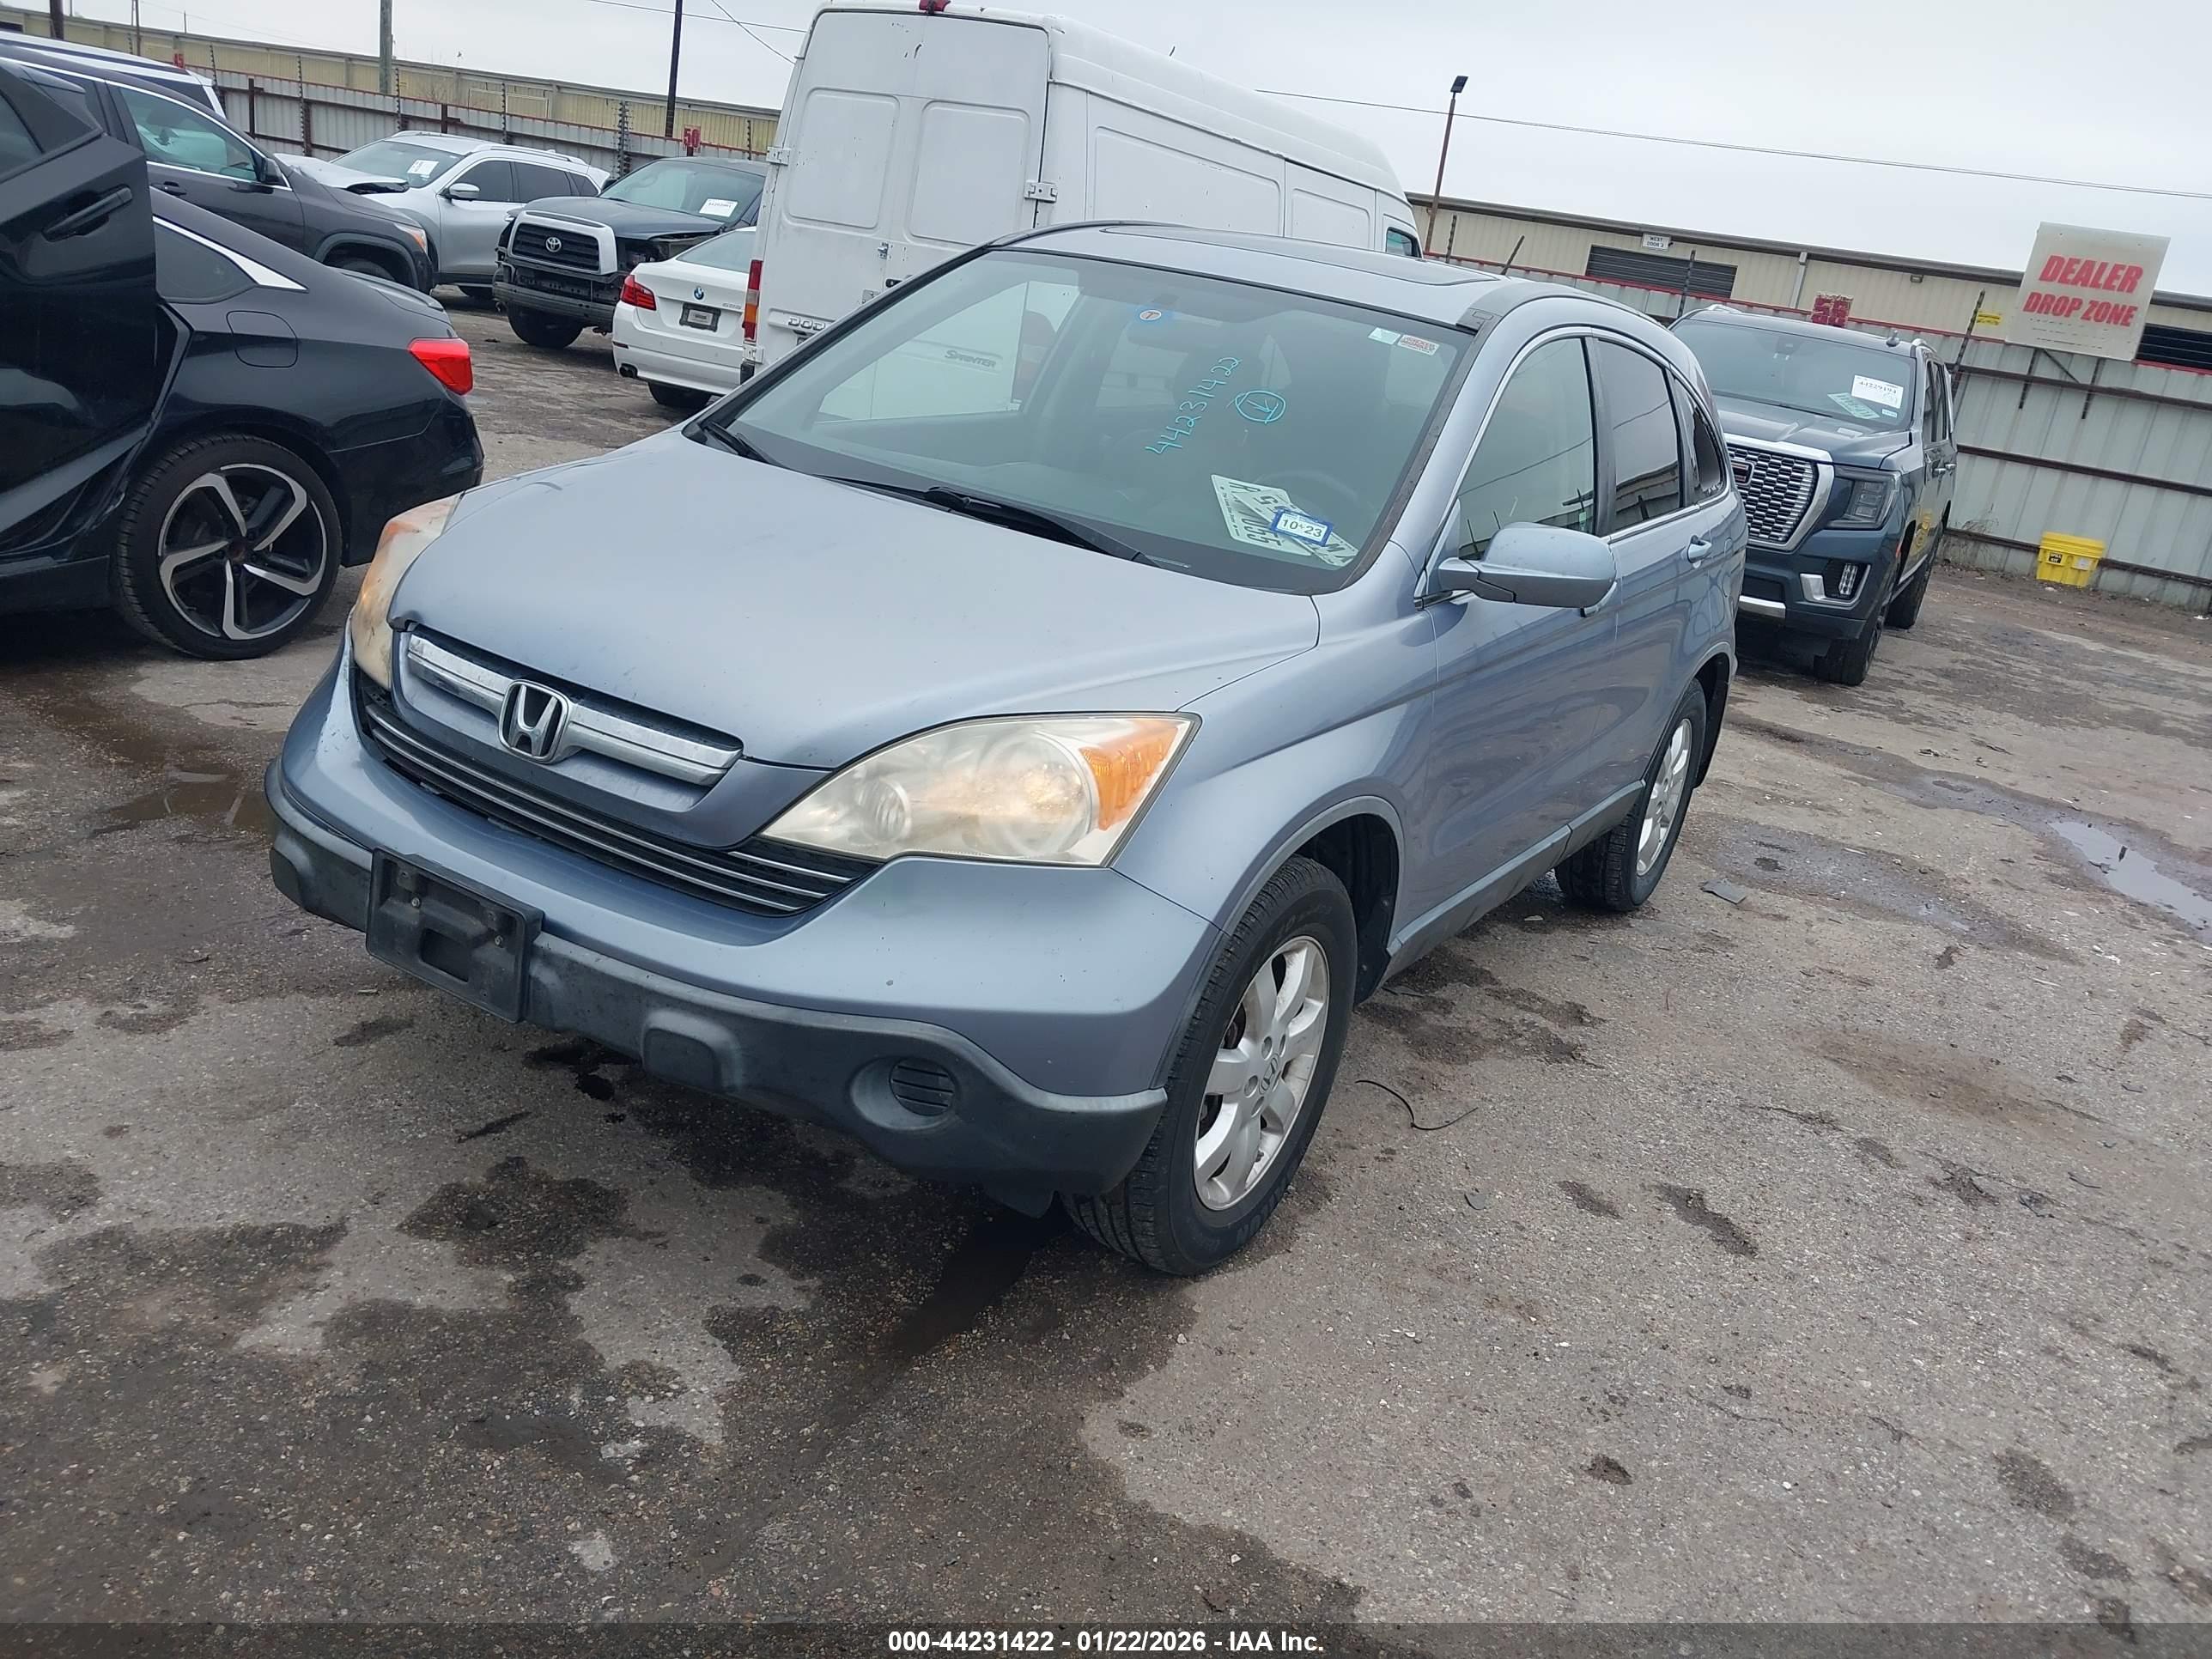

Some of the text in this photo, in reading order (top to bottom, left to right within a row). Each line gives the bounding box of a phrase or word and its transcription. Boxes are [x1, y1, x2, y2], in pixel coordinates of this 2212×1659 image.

[2039, 255, 2143, 294] DEALER
[2022, 292, 2139, 327] DROP ZONE
[1145, 357, 1243, 454] 44231422
